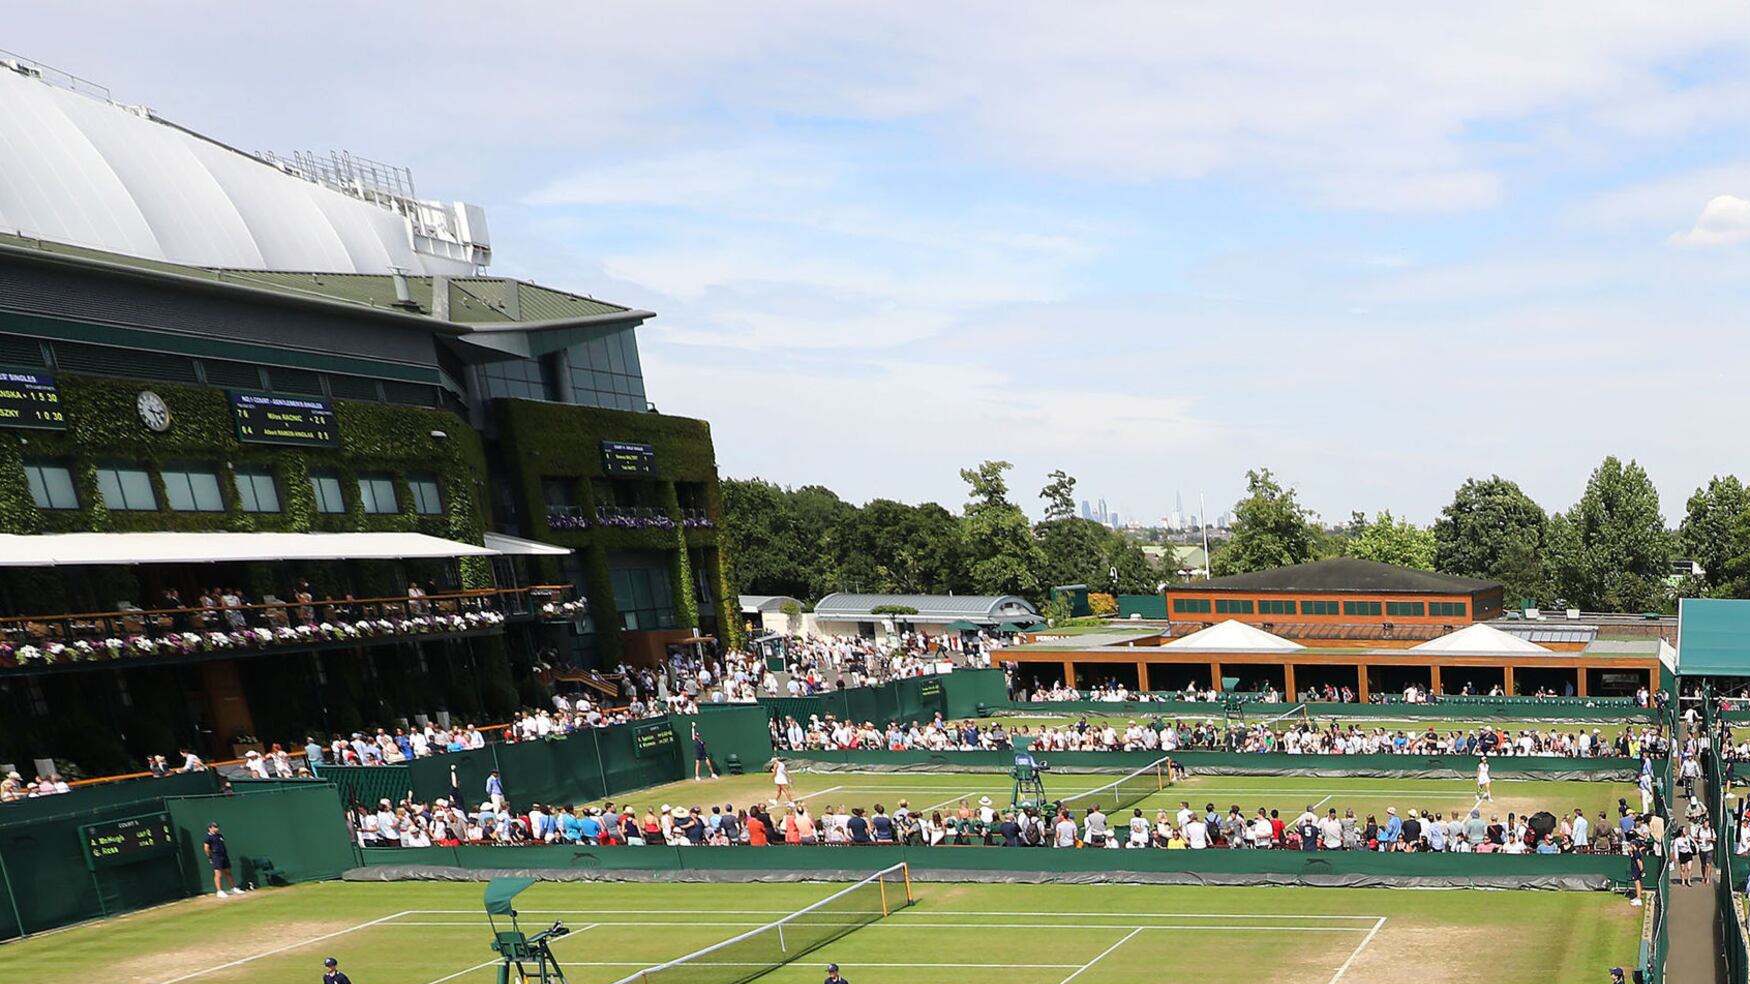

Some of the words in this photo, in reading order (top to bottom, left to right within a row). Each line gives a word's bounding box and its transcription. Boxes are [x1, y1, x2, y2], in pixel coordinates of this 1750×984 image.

[47, 393, 58, 402] 30
[52, 412, 63, 421] 30
[1304, 827, 1312, 837] 5
